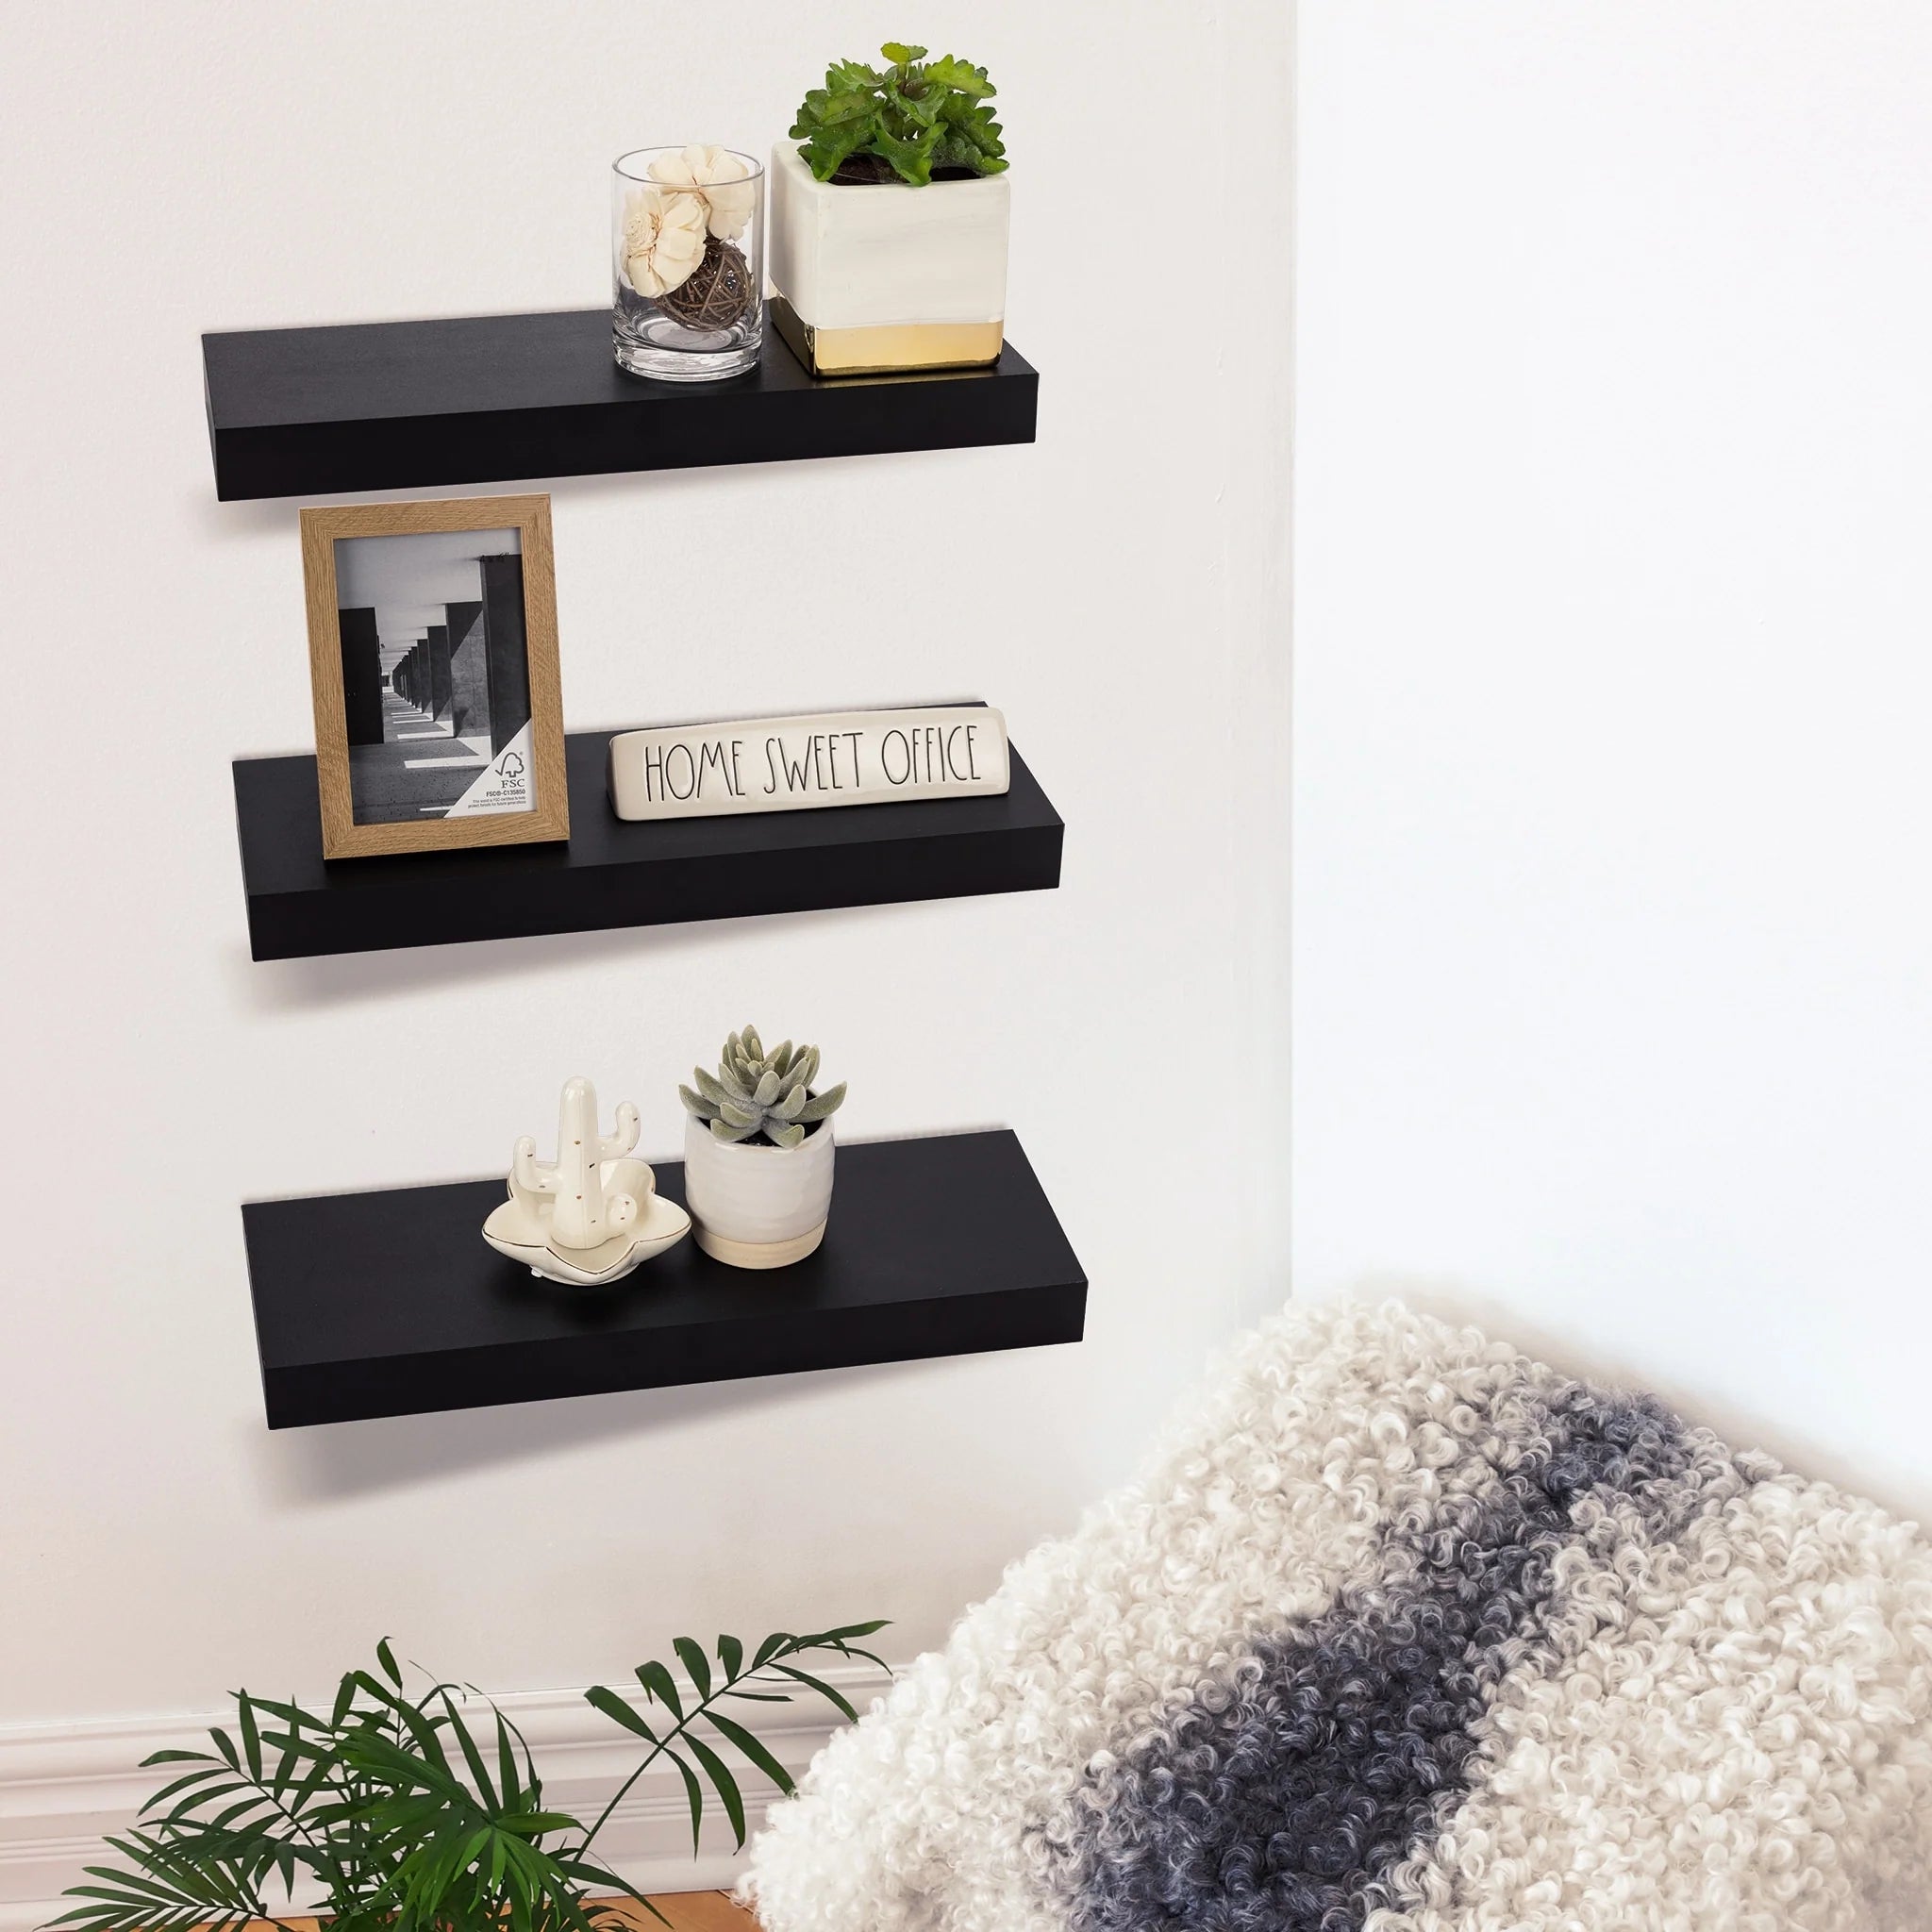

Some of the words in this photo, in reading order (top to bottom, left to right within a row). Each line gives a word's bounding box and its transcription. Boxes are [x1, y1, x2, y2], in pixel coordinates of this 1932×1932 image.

[501, 778, 525, 789] FSC
[645, 740, 746, 802] HOME
[763, 731, 864, 794] SWEET
[881, 724, 982, 785] OFFICE
